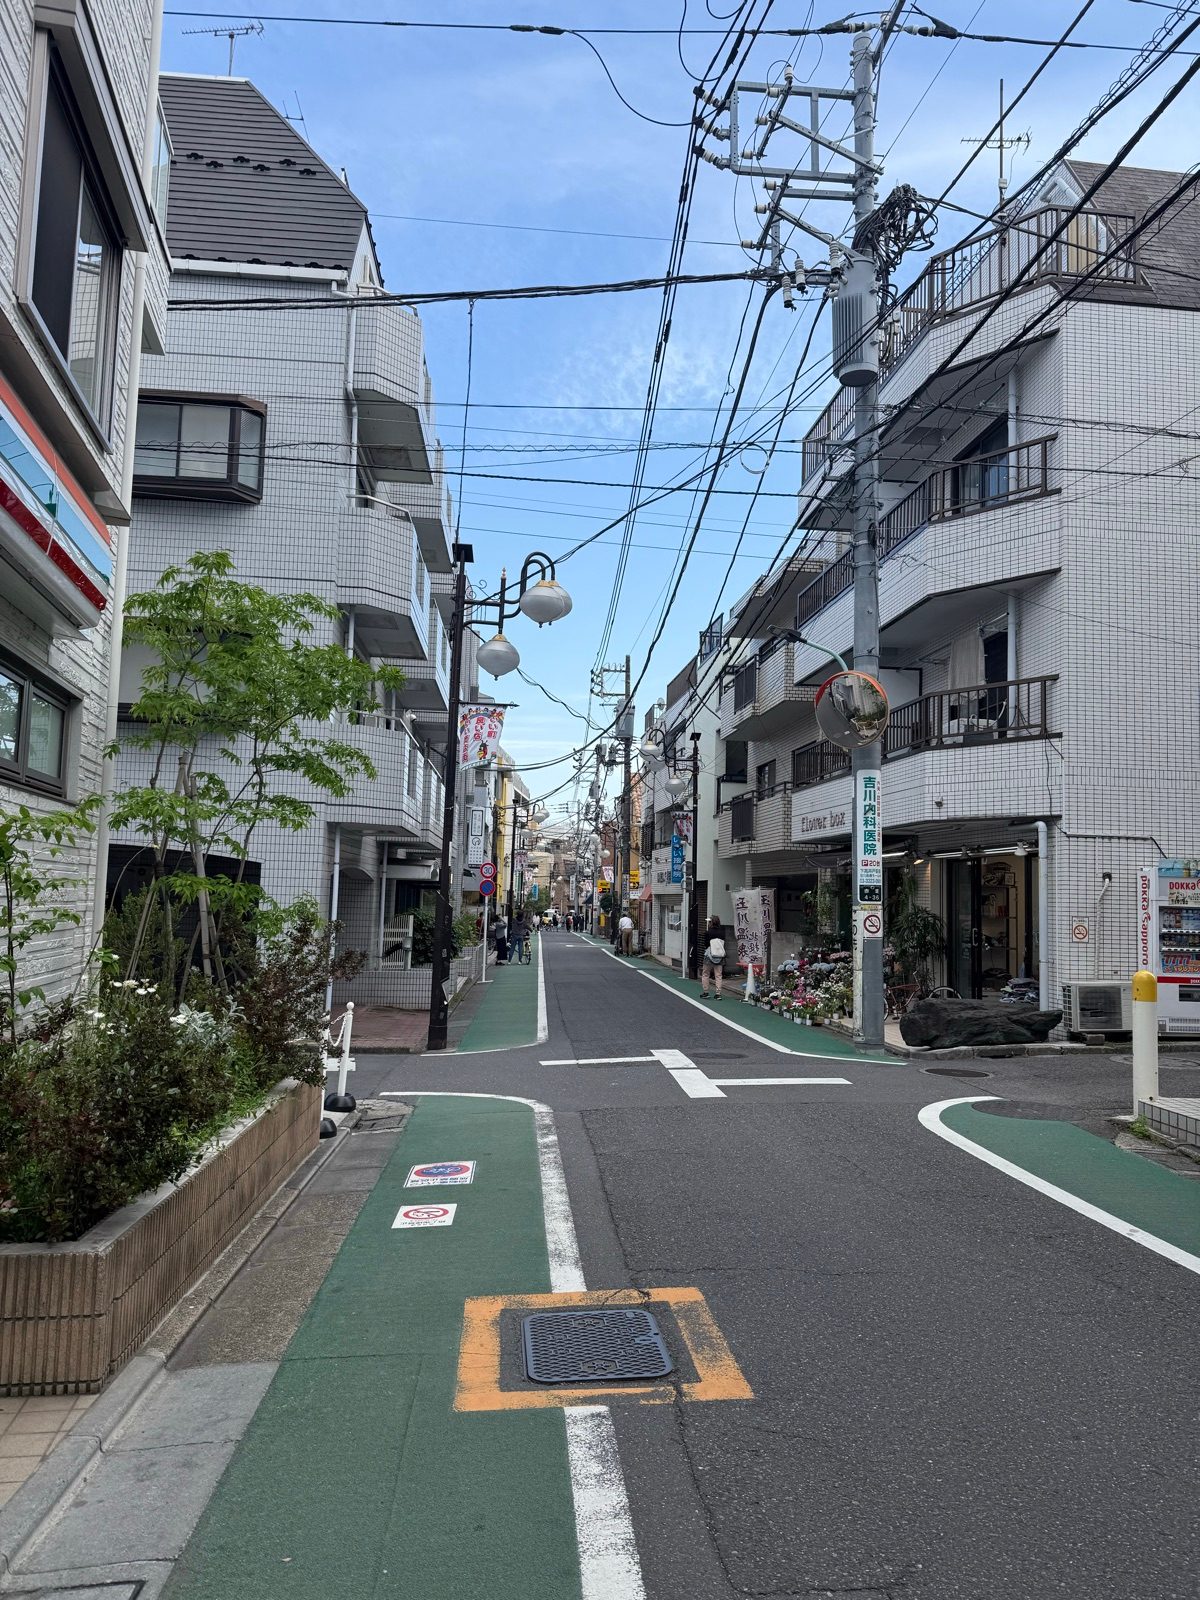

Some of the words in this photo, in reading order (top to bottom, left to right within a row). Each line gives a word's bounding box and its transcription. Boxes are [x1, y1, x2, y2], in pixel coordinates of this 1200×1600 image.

[829, 811, 846, 828] box
[863, 776, 877, 856] 吉川内科医院
[483, 866, 493, 875] 30
[1140, 875, 1148, 911] pokka
[736, 897, 749, 957] 玉川温泉
